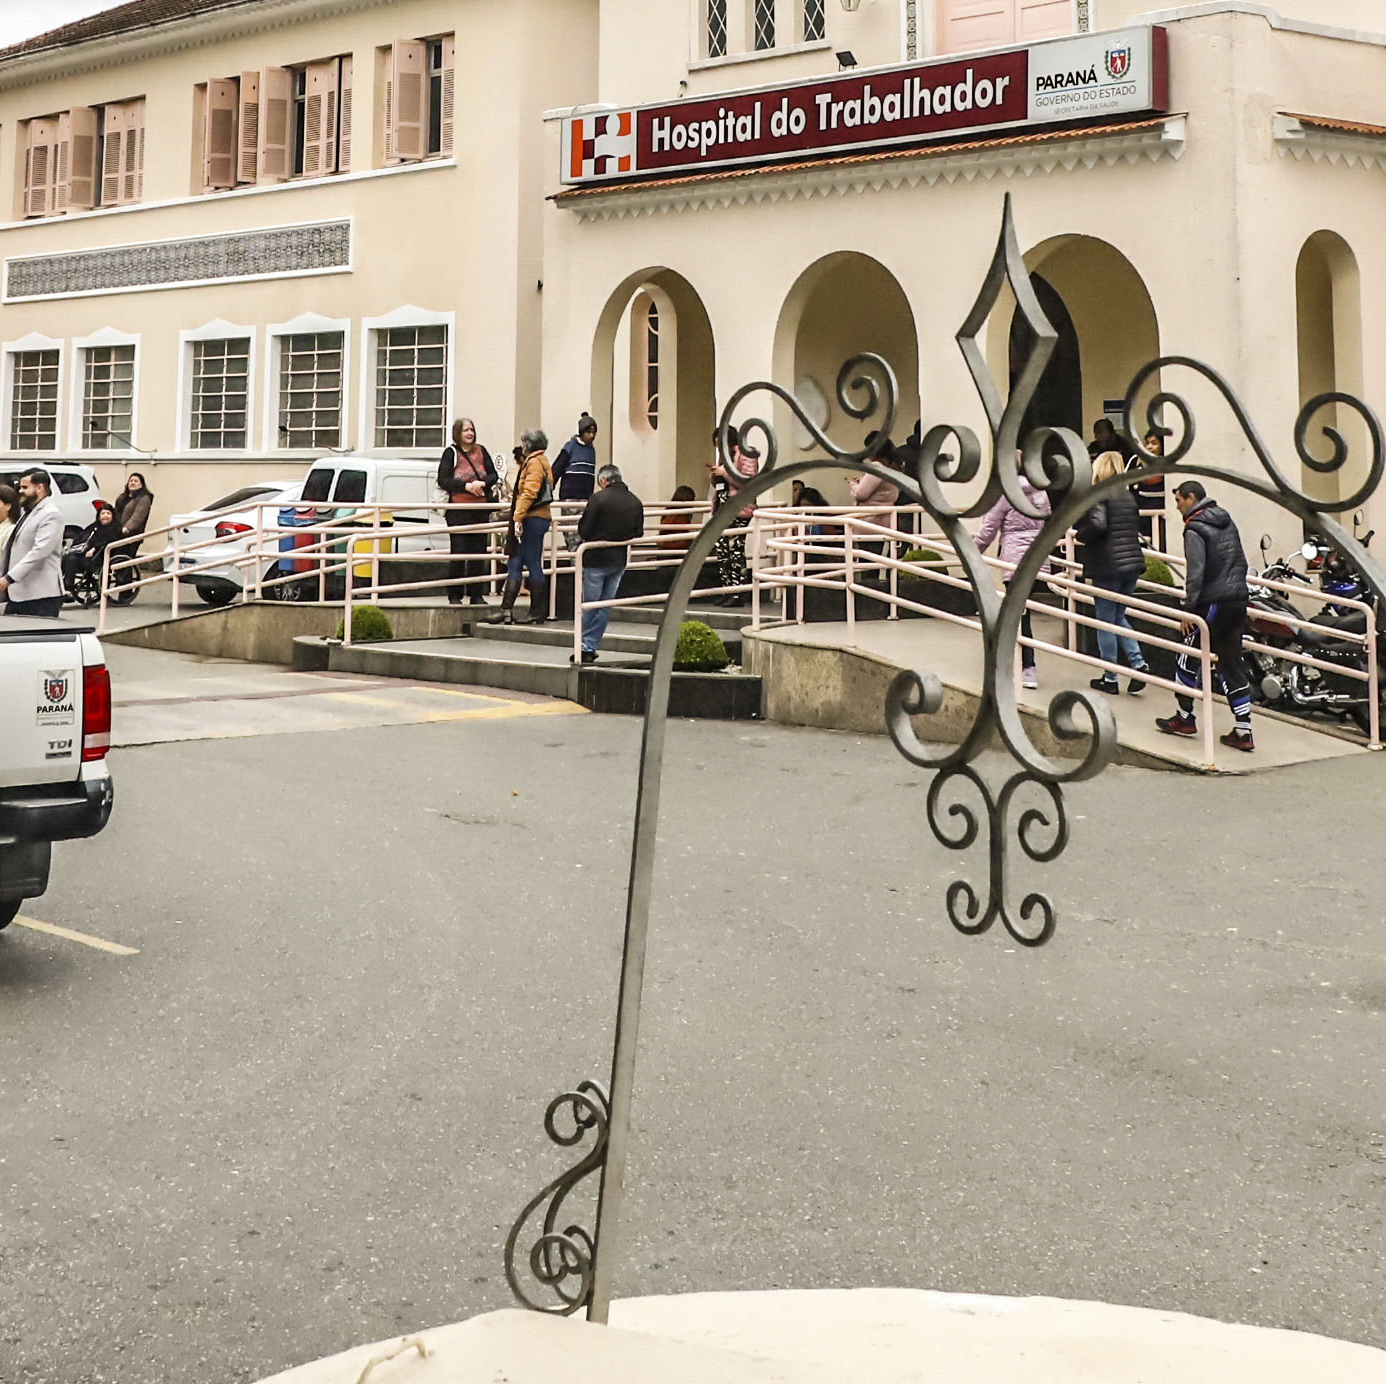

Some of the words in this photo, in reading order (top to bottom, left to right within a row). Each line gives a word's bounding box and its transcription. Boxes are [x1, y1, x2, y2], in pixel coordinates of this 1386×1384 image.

[1035, 64, 1099, 92] PARANÁ
[1035, 92, 1081, 108] GOVERNO
[1082, 90, 1097, 101] DO
[1099, 85, 1137, 99] ESTADO
[651, 101, 762, 157] Hospital
[770, 97, 807, 138] do
[815, 68, 1011, 131] Trabalhador
[36, 702, 75, 714] PARANÁ
[47, 739, 73, 750] TDI
